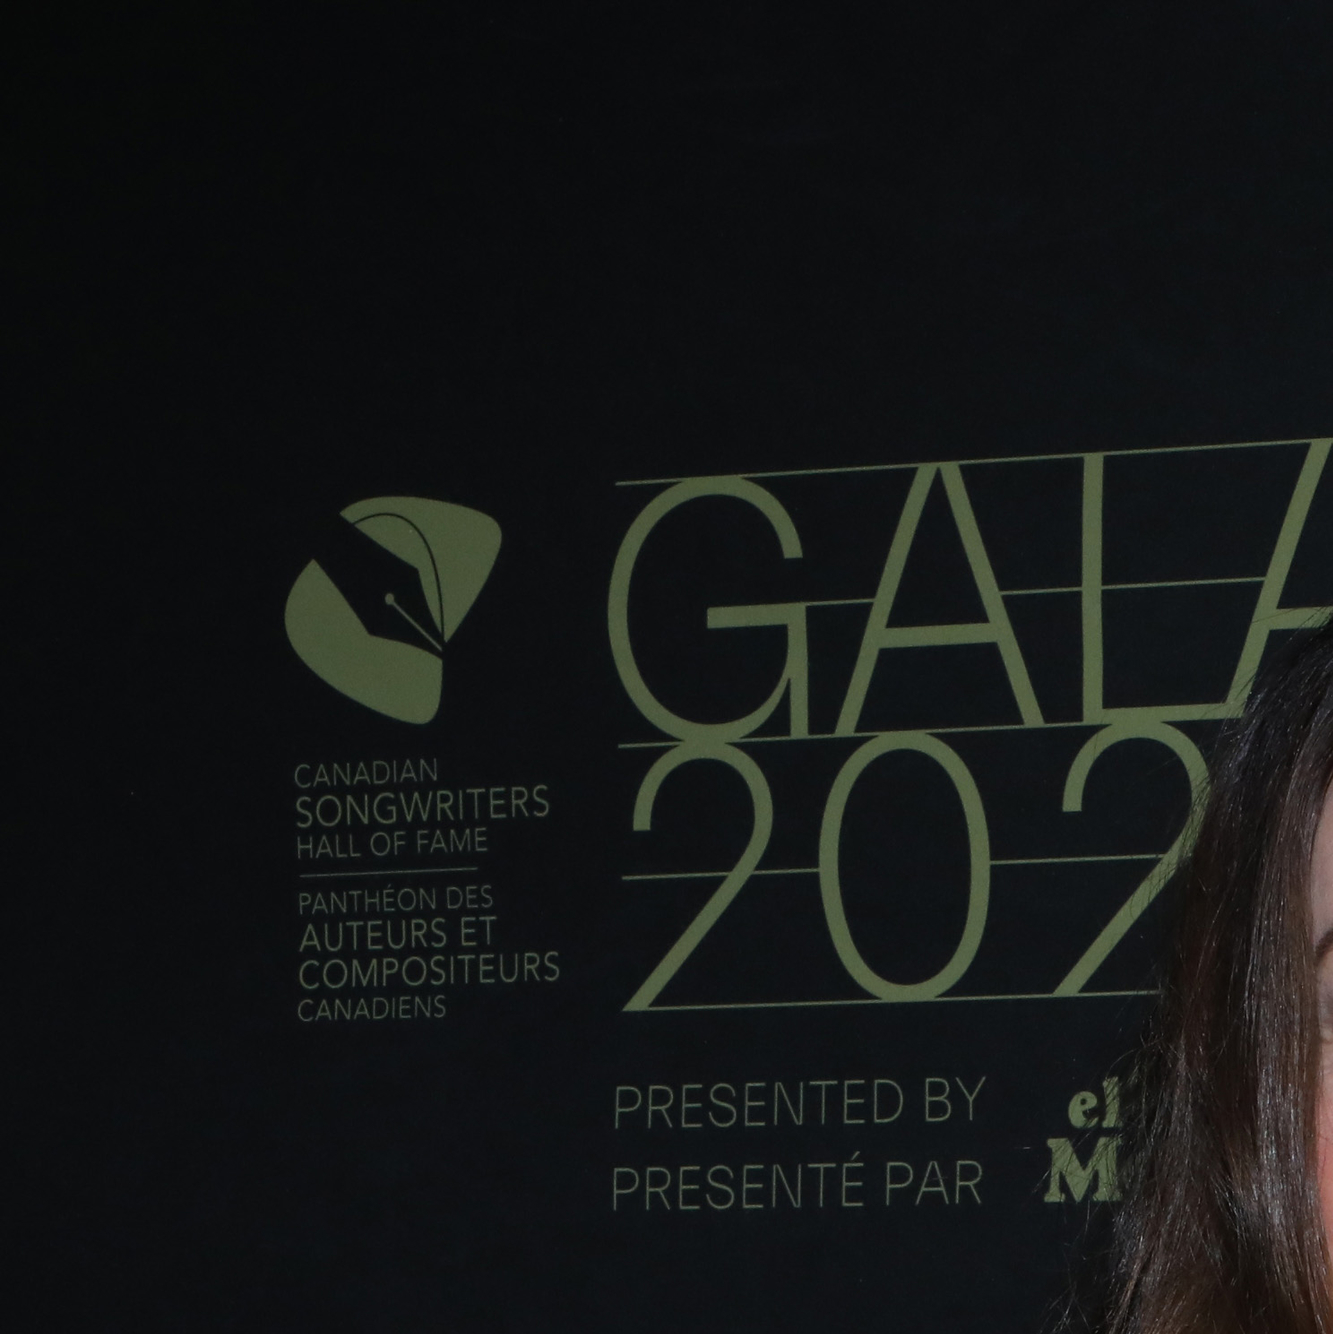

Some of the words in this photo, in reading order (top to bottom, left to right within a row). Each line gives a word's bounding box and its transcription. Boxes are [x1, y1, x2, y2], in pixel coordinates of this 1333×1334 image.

[294, 758, 438, 789] CANADIAN
[295, 784, 550, 829] SONGWRITERS
[297, 834, 362, 859] HALL
[369, 830, 407, 857] OF
[416, 827, 489, 853] FAME
[622, 720, 1210, 1011] 202
[299, 883, 437, 915] PANTHÉON
[446, 884, 494, 910] DES
[299, 918, 448, 952] AUTEURS
[460, 915, 498, 947] ET
[298, 950, 561, 990] COMPOSITEURS
[297, 994, 447, 1022] CANADIENS
[613, 1078, 905, 1129] PRESENTED
[924, 1075, 987, 1122] BY
[611, 1150, 865, 1210] PRESENTÉ
[885, 1159, 984, 1206] PAR
